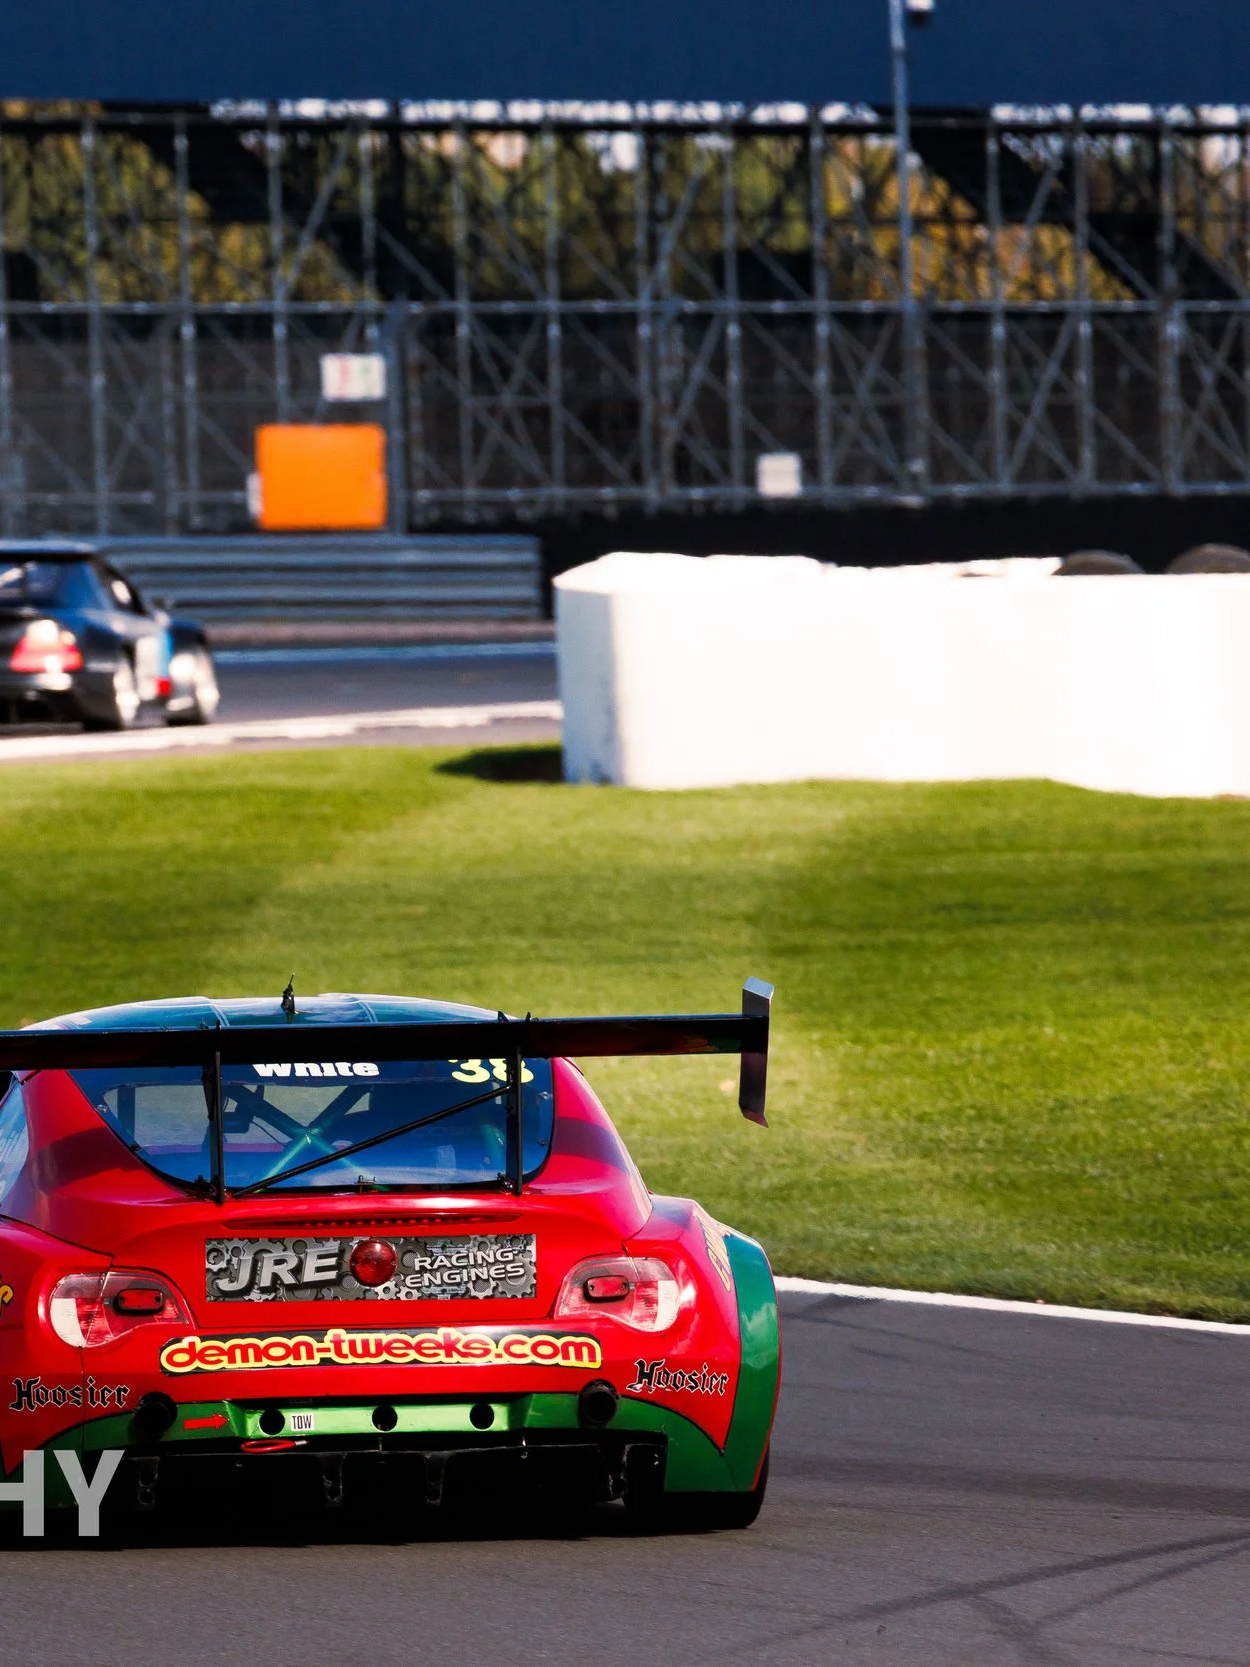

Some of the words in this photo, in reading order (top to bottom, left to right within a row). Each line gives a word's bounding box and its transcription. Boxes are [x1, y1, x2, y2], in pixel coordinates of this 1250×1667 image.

[216, 1246, 339, 1292] JRE
[404, 1263, 526, 1288] ENGINES
[414, 1248, 516, 1271] RACING
[161, 1329, 601, 1371] demon-tweeks.com
[9, 1376, 130, 1412] Hoosier
[626, 1358, 729, 1396] Hoosier
[291, 1415, 312, 1431] TOW
